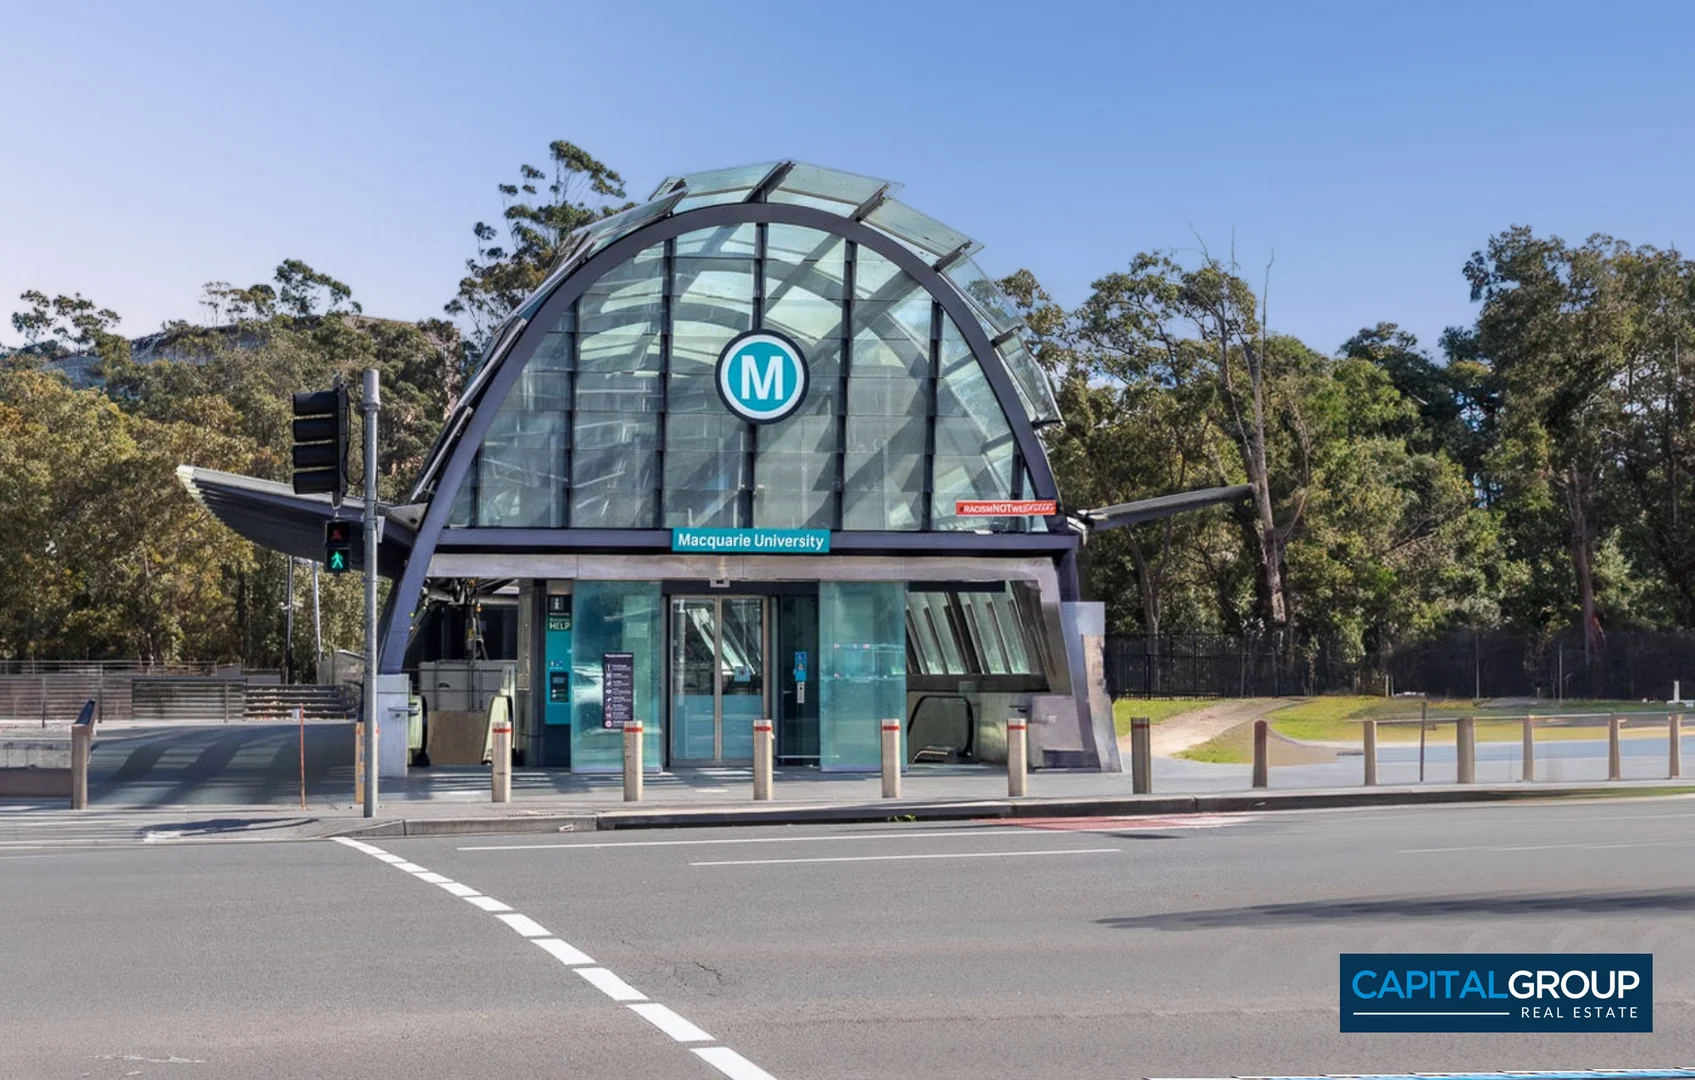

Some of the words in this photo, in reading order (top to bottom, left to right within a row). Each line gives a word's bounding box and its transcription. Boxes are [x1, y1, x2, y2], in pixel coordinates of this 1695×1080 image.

[741, 355, 783, 400] M
[678, 533, 750, 549] Macquarie
[754, 534, 824, 550] University
[549, 622, 571, 630] HELP
